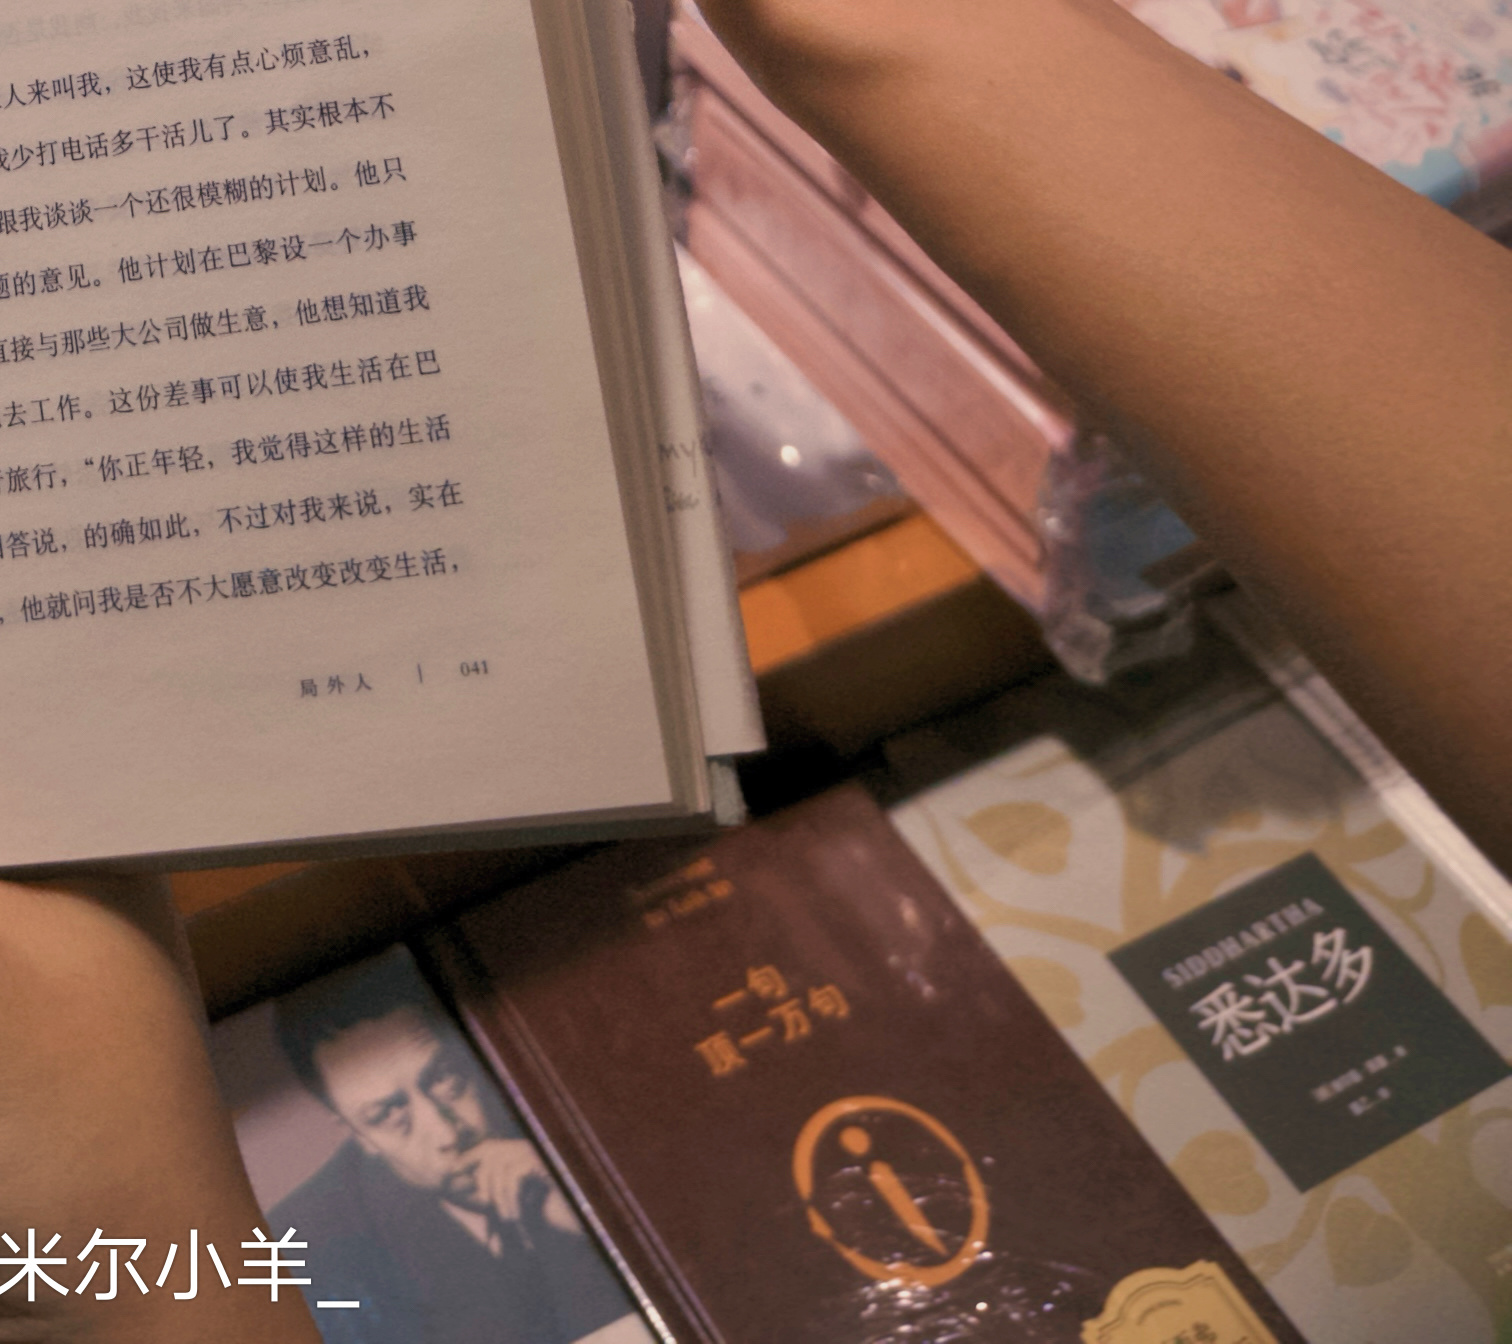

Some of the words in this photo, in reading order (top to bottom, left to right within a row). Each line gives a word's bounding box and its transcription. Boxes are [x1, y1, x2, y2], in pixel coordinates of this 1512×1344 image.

[299, 672, 372, 698] 局外人
[459, 659, 490, 678] 041
[1161, 897, 1325, 991] SIDDHARTHA
[711, 963, 790, 1012] 一句
[1188, 926, 1374, 1062] 悉达多
